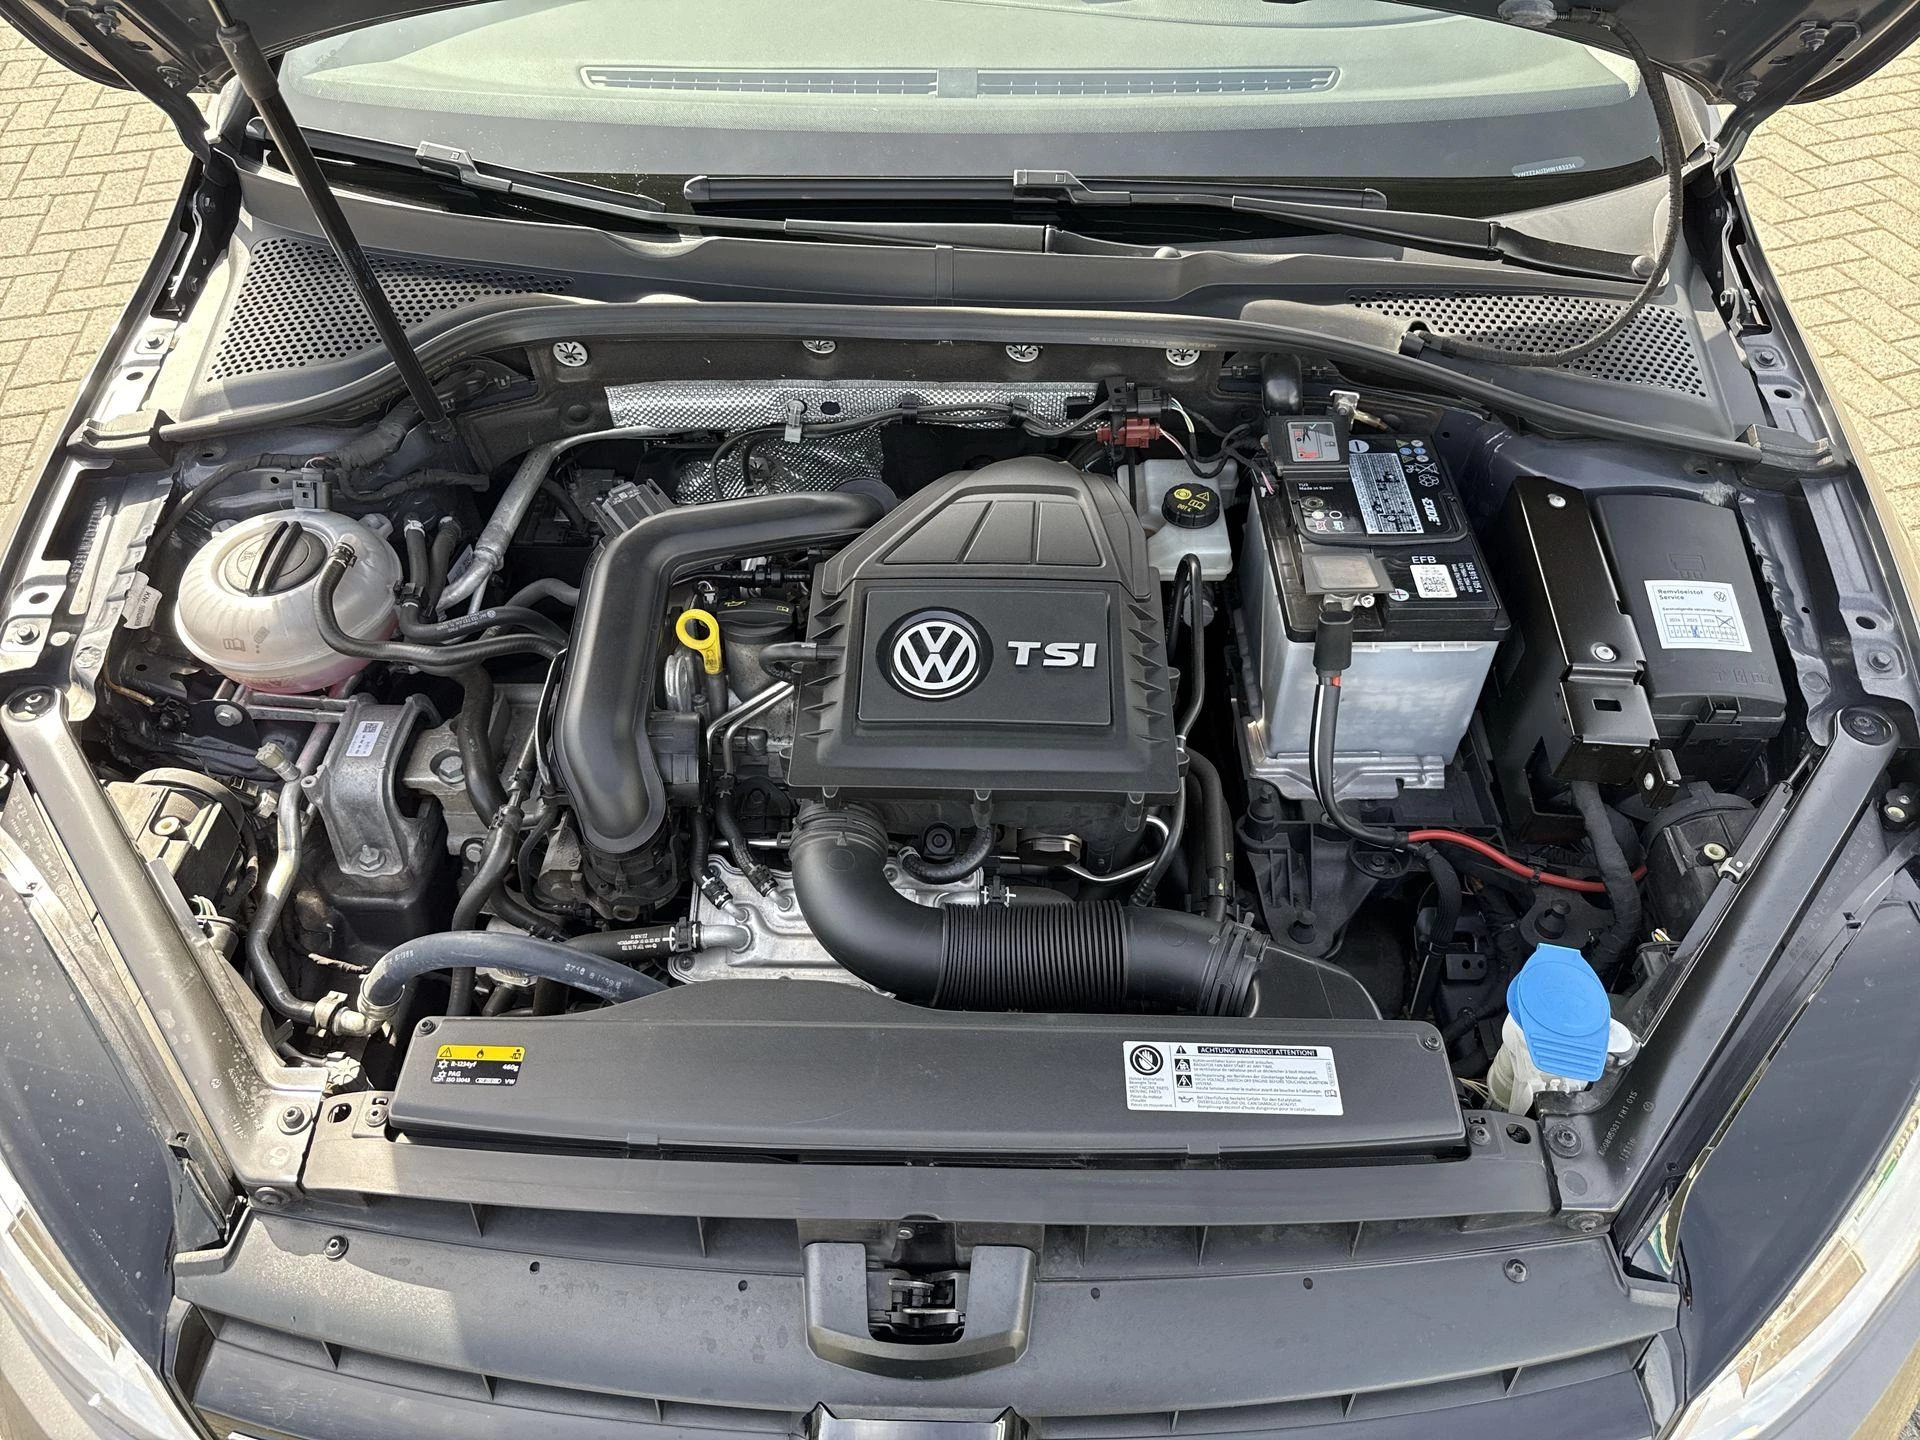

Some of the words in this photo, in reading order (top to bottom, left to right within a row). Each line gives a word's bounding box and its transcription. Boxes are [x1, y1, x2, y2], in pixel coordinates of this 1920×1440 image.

[1411, 555, 1437, 564] EFB
[893, 621, 977, 690] VW
[1007, 640, 1097, 668] TSI
[450, 1061, 478, 1070] R-1234yf
